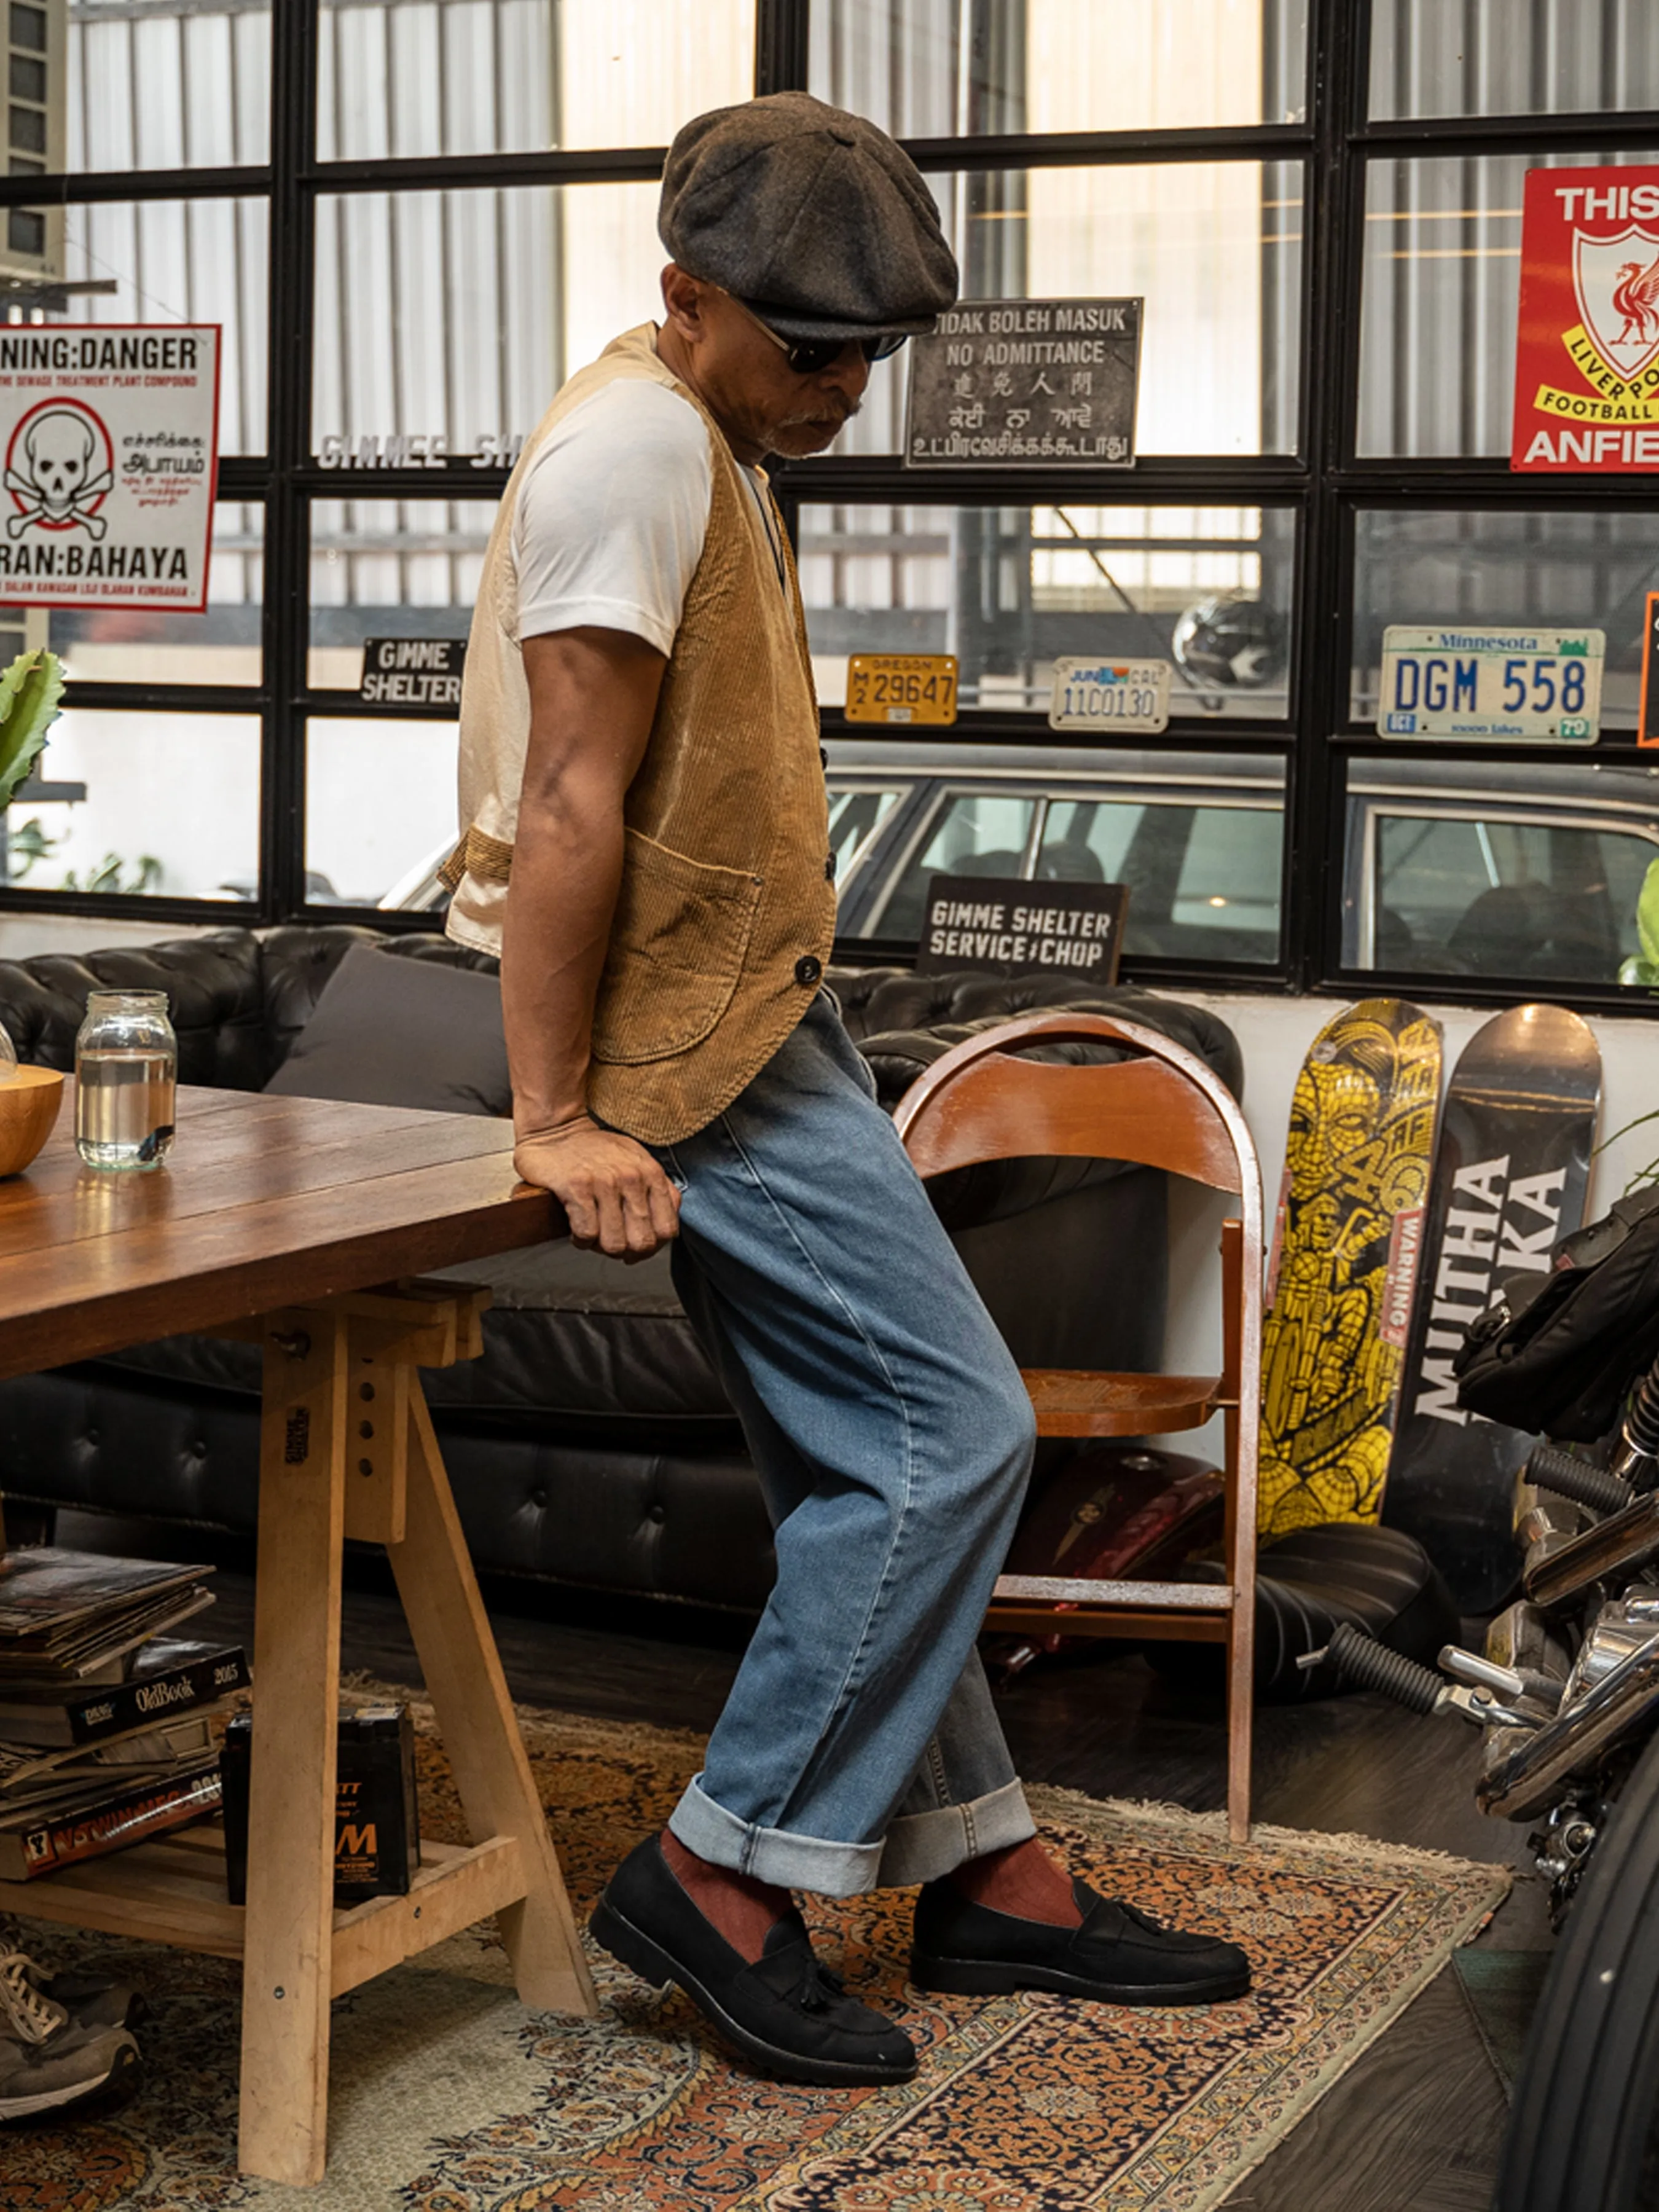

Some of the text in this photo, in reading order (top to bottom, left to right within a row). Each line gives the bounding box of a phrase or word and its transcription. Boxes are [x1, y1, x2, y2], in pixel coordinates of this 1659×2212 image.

[1555, 184, 1659, 221] THIS
[989, 310, 1049, 333] BOLEH
[1056, 307, 1126, 331] MASUK
[946, 340, 1105, 366] NO ADMITTANCE
[112, 375, 142, 388] PLANT
[1542, 392, 1652, 420] FOOTBALL
[318, 434, 449, 470] GIMMEE
[378, 641, 452, 670] GIMME
[1439, 633, 1538, 651] Minnesota
[872, 659, 932, 671] OREGON
[361, 672, 461, 704] SHELTER
[873, 675, 954, 705] 29647
[1395, 658, 1586, 713] DGM 558
[930, 900, 1112, 938] GIMME SHELTER
[929, 930, 1104, 968] SERVICE CHOP
[1389, 1216, 1421, 1327] WARNING
[1414, 1154, 1510, 1427] MUTHA
